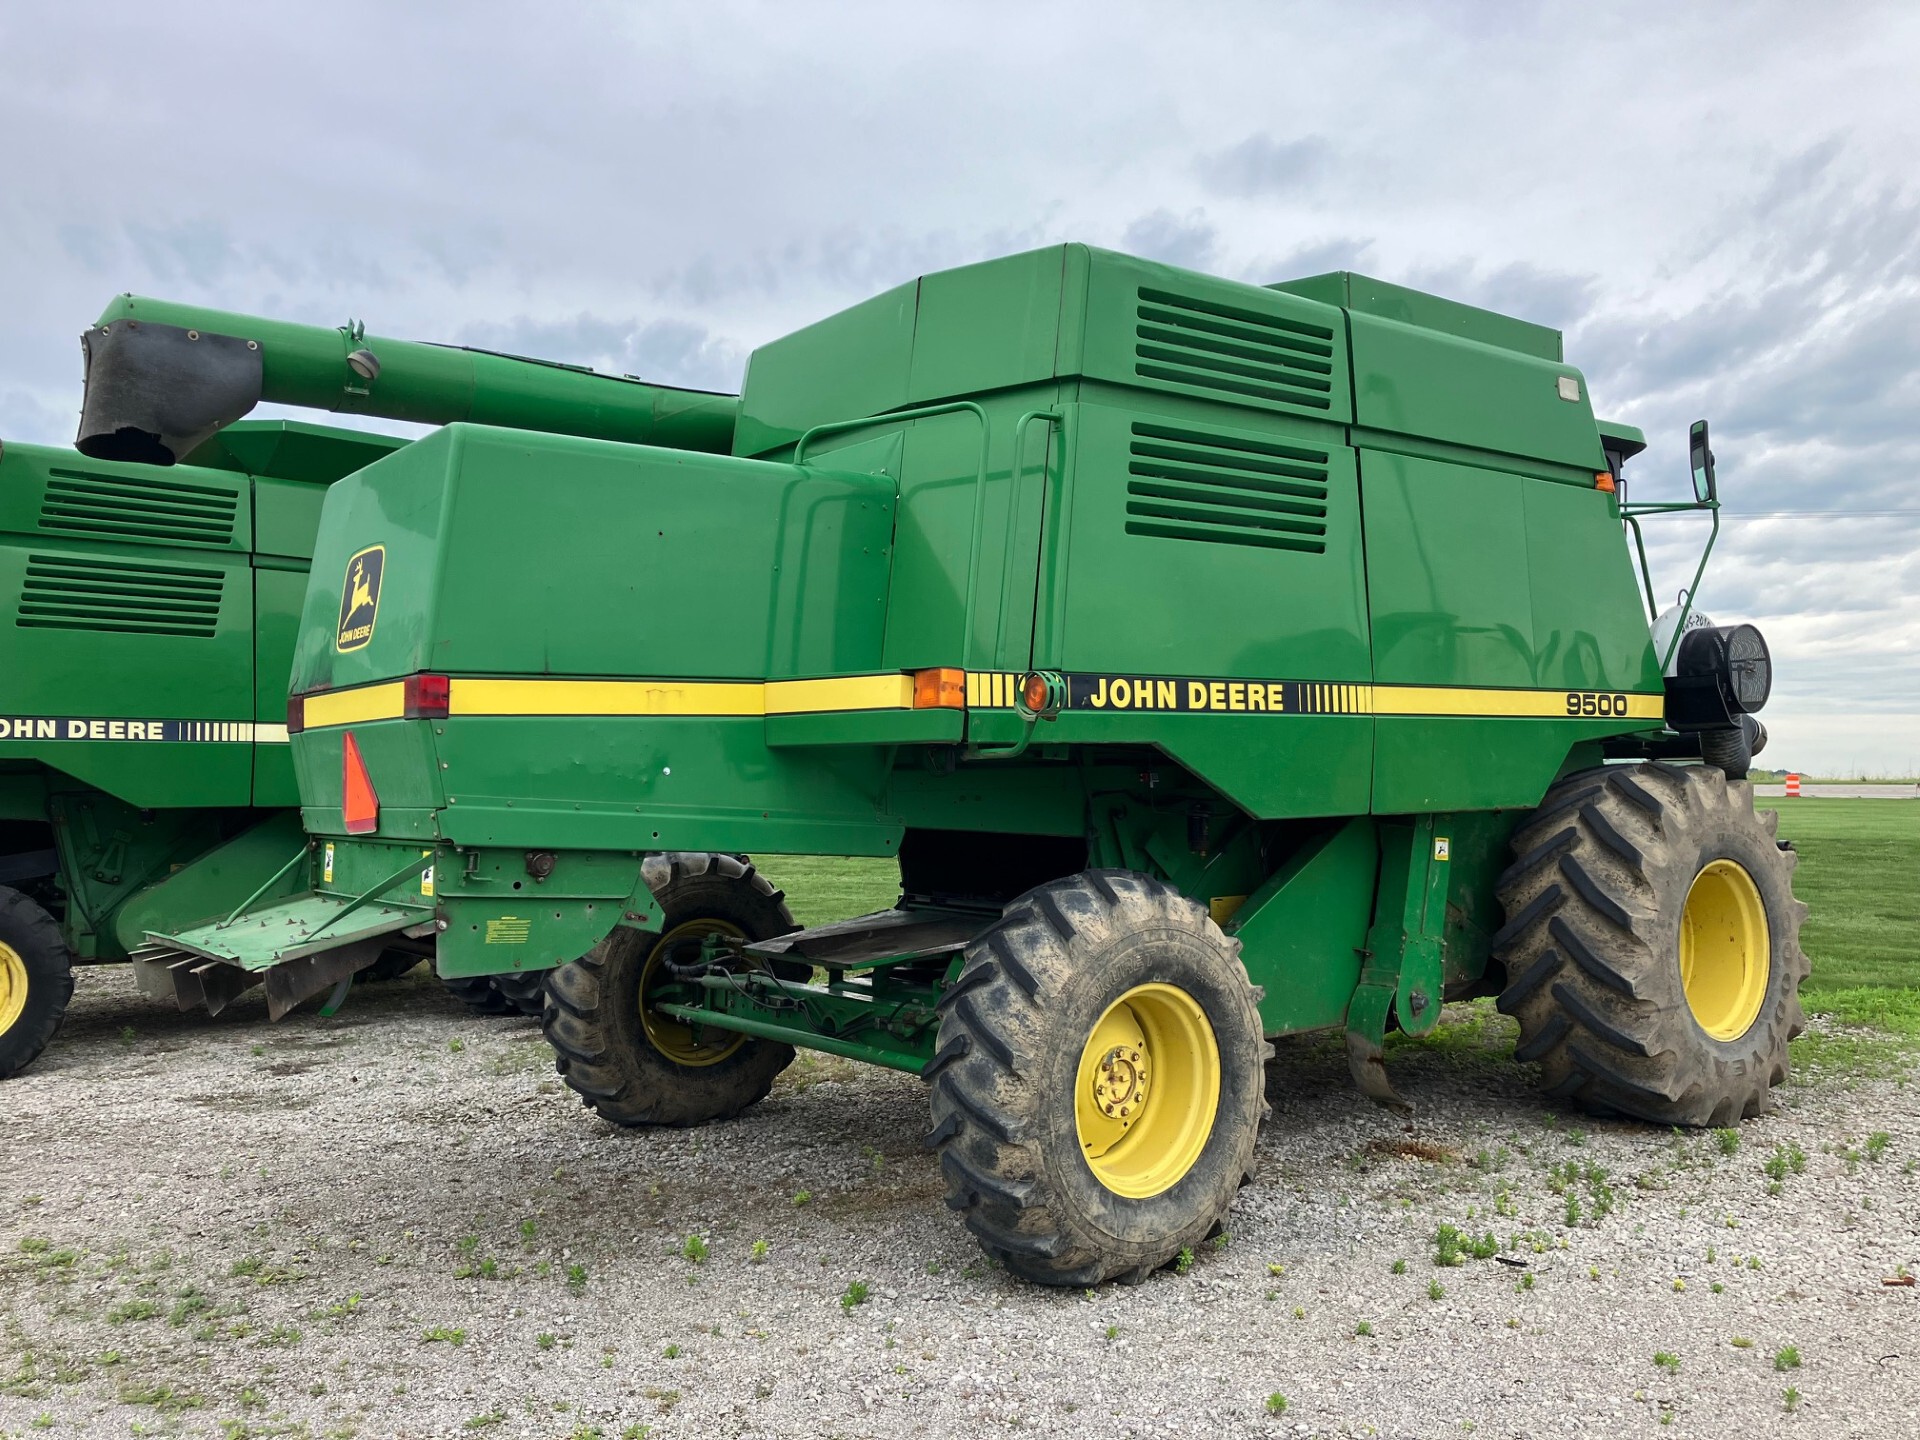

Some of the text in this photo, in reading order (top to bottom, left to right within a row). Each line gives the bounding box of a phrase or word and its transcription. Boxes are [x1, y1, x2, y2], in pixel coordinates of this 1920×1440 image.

[339, 624, 371, 644] JOHN DEERE
[1090, 678, 1284, 711] JOHN DEERE
[1566, 693, 1628, 716] 9500
[0, 718, 164, 740] OHN DEERE
